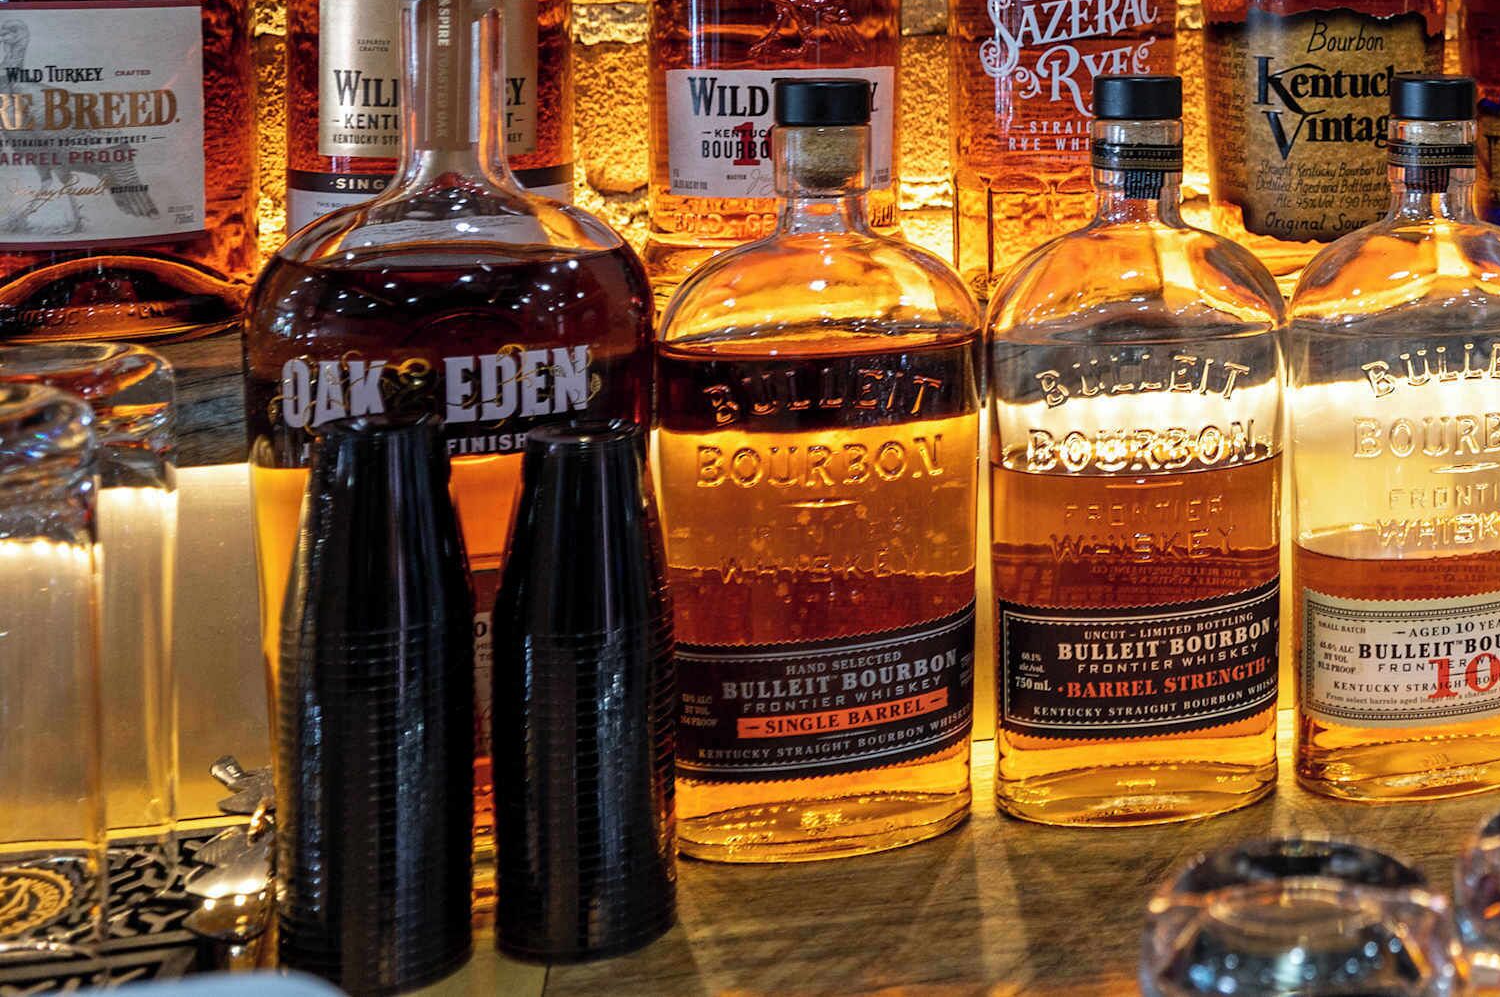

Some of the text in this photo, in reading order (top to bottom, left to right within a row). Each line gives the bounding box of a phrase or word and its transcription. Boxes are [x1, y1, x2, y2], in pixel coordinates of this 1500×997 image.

[1306, 20, 1385, 54] Bourbon
[5, 65, 151, 83] WILD TURKEY CRAFTED
[1036, 36, 1157, 118] RYE
[688, 76, 769, 117] WILD
[332, 133, 378, 145] KENTUCKY
[1008, 137, 1041, 152] RYE
[67, 149, 138, 164] PROOF
[1295, 162, 1337, 181] Kentucky
[1264, 211, 1370, 235] Original Sour
[281, 344, 592, 429] OAK EDEN
[1035, 353, 1250, 407] BULLEIT
[1026, 418, 1256, 473] BOURBON
[696, 433, 945, 489] BOURBON
[1057, 617, 1271, 661] BULLEIT BOURBON
[1083, 612, 1254, 640] UNCUT LIMITED BOTTLING
[1318, 621, 1366, 635] SMALL BATCH
[1408, 626, 1450, 638] AGED
[1455, 621, 1475, 634] 10
[785, 651, 902, 676] HAND SELECTED
[1077, 642, 1258, 674] FRONTIER WHISKEY
[1358, 640, 1456, 660] BULLEIT
[722, 648, 958, 700] BULLEIT BOURBON
[1066, 658, 1266, 698] BARREL STRENGTH
[1330, 663, 1357, 674] PROOF
[1377, 658, 1467, 673] FRONTIER
[743, 695, 846, 714] FRONTIER
[854, 674, 943, 704] WHISKEY
[1326, 692, 1397, 705] From select barrels
[1333, 679, 1399, 694] KENTUCKY
[1406, 678, 1469, 693] STRAIGHT
[765, 698, 926, 734] SINGLE BARREL
[1033, 689, 1243, 717] KENTUCKY STRAIGHT BOURBON
[698, 724, 925, 760] KENTUCKY STRAIGHT BOURBON
